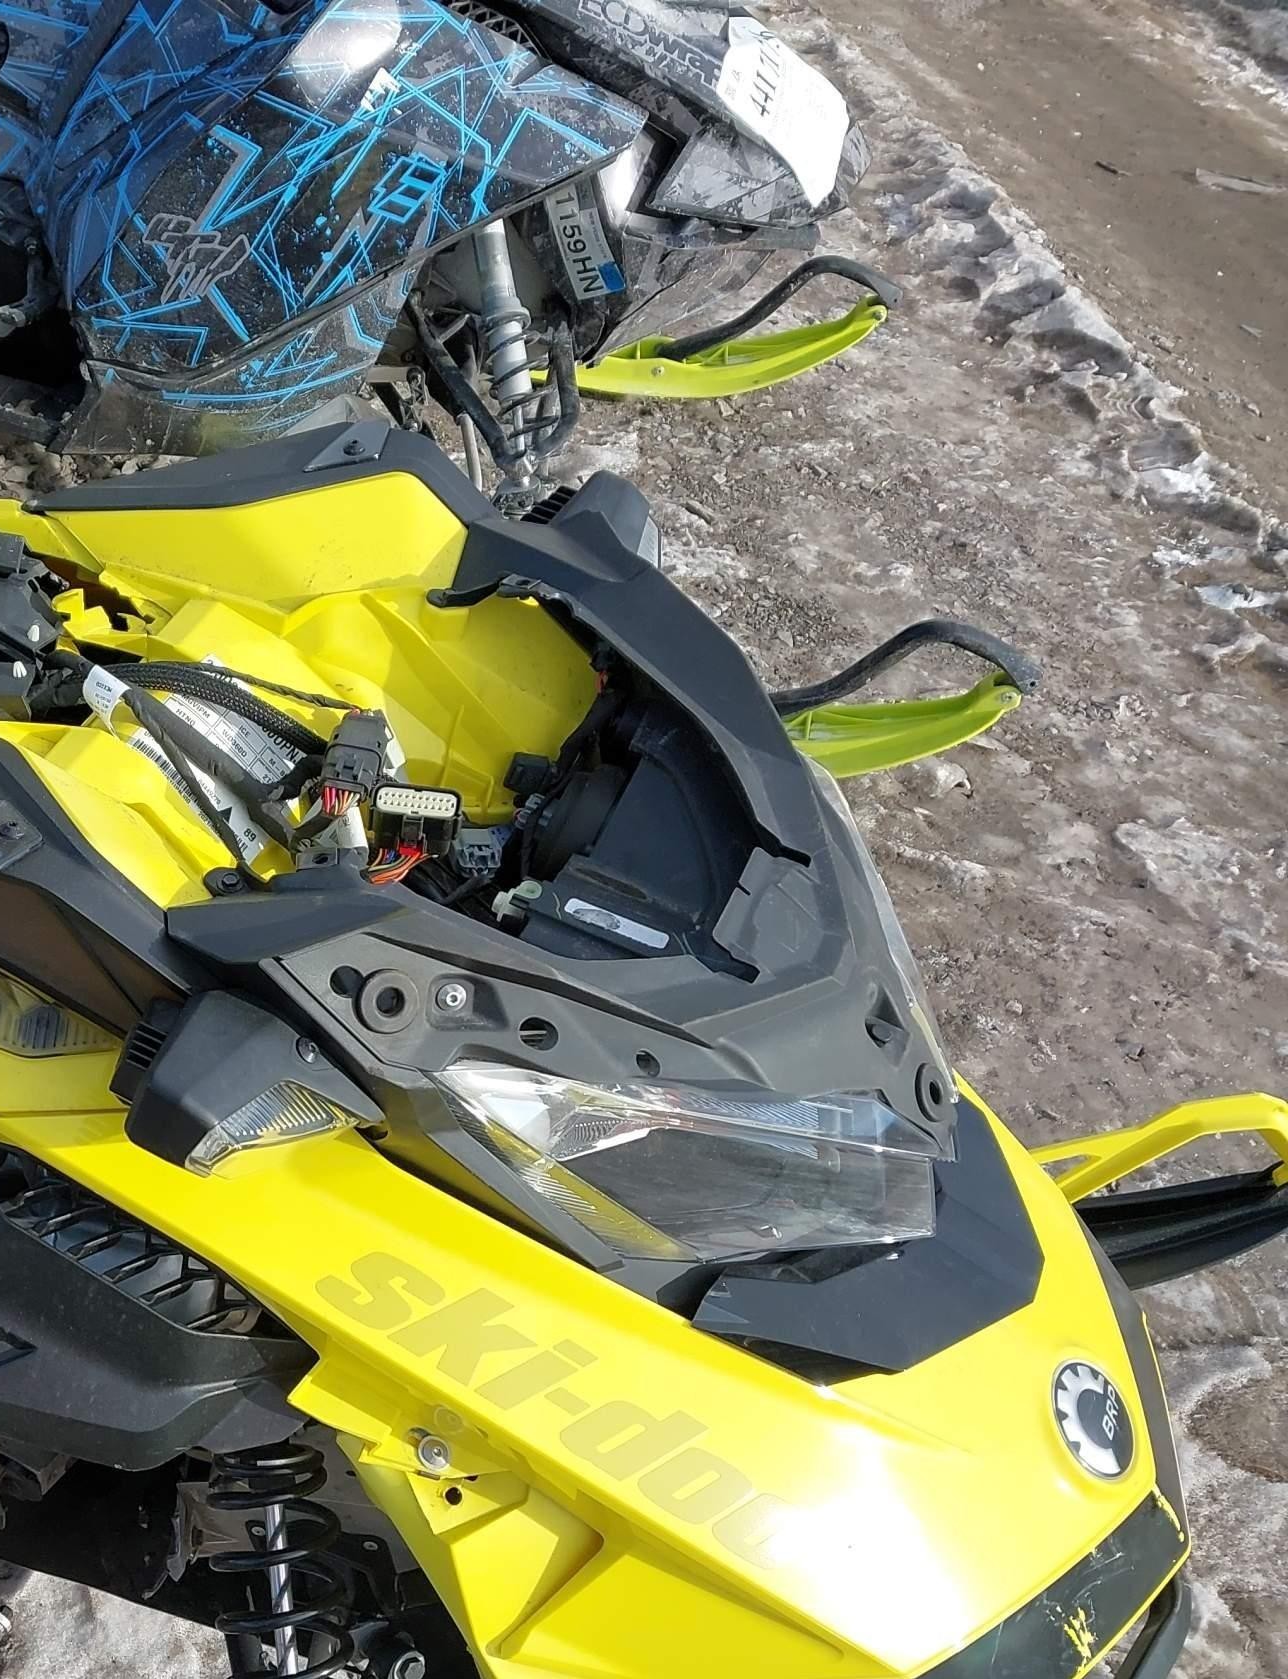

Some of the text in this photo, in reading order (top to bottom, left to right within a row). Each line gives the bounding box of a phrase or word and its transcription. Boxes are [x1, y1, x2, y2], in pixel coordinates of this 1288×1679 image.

[555, 191, 605, 294] 1159HN
[243, 827, 258, 842] 89
[1102, 1384, 1119, 1441] BRP
